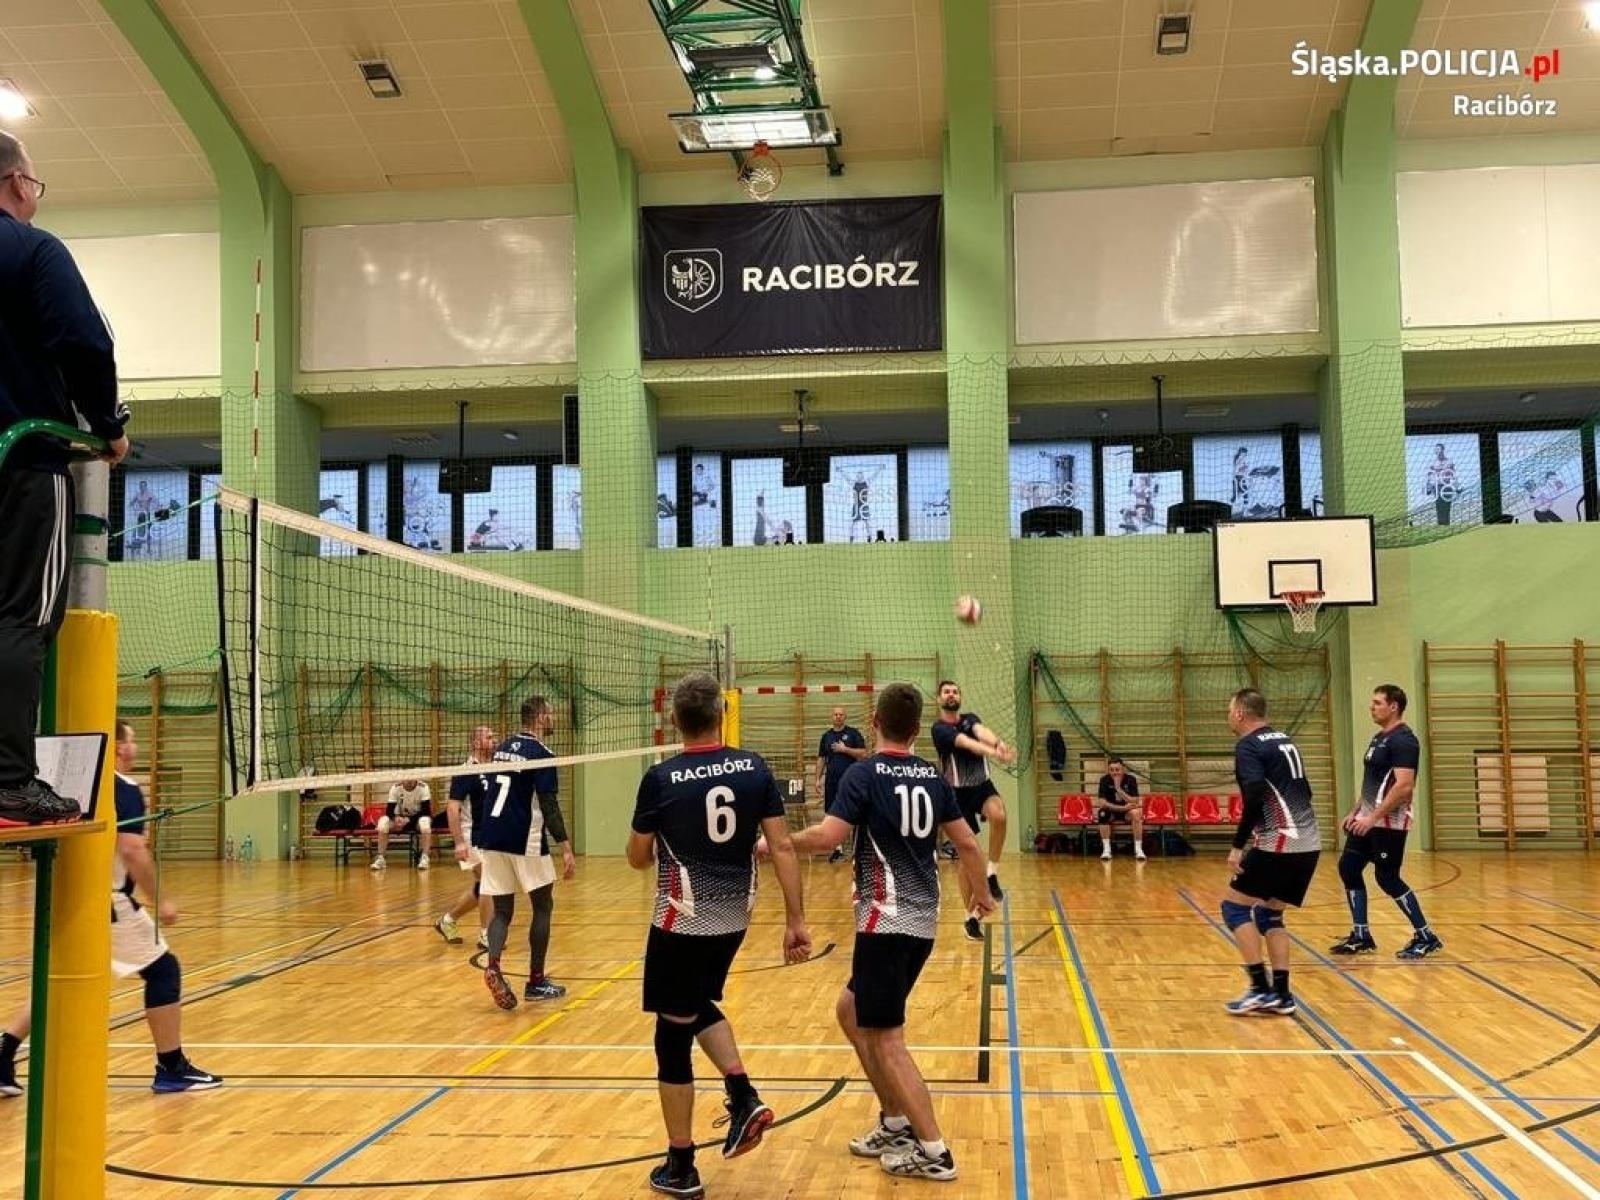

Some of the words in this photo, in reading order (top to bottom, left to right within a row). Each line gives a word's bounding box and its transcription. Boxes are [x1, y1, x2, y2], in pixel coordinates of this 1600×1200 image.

[742, 254, 920, 293] RACIBÓRZ
[671, 757, 755, 784] RACIBÓRZ
[876, 762, 938, 779] RACIBÓRZ
[490, 774, 511, 818] 7
[705, 785, 737, 843] 6
[894, 784, 934, 839] 10
